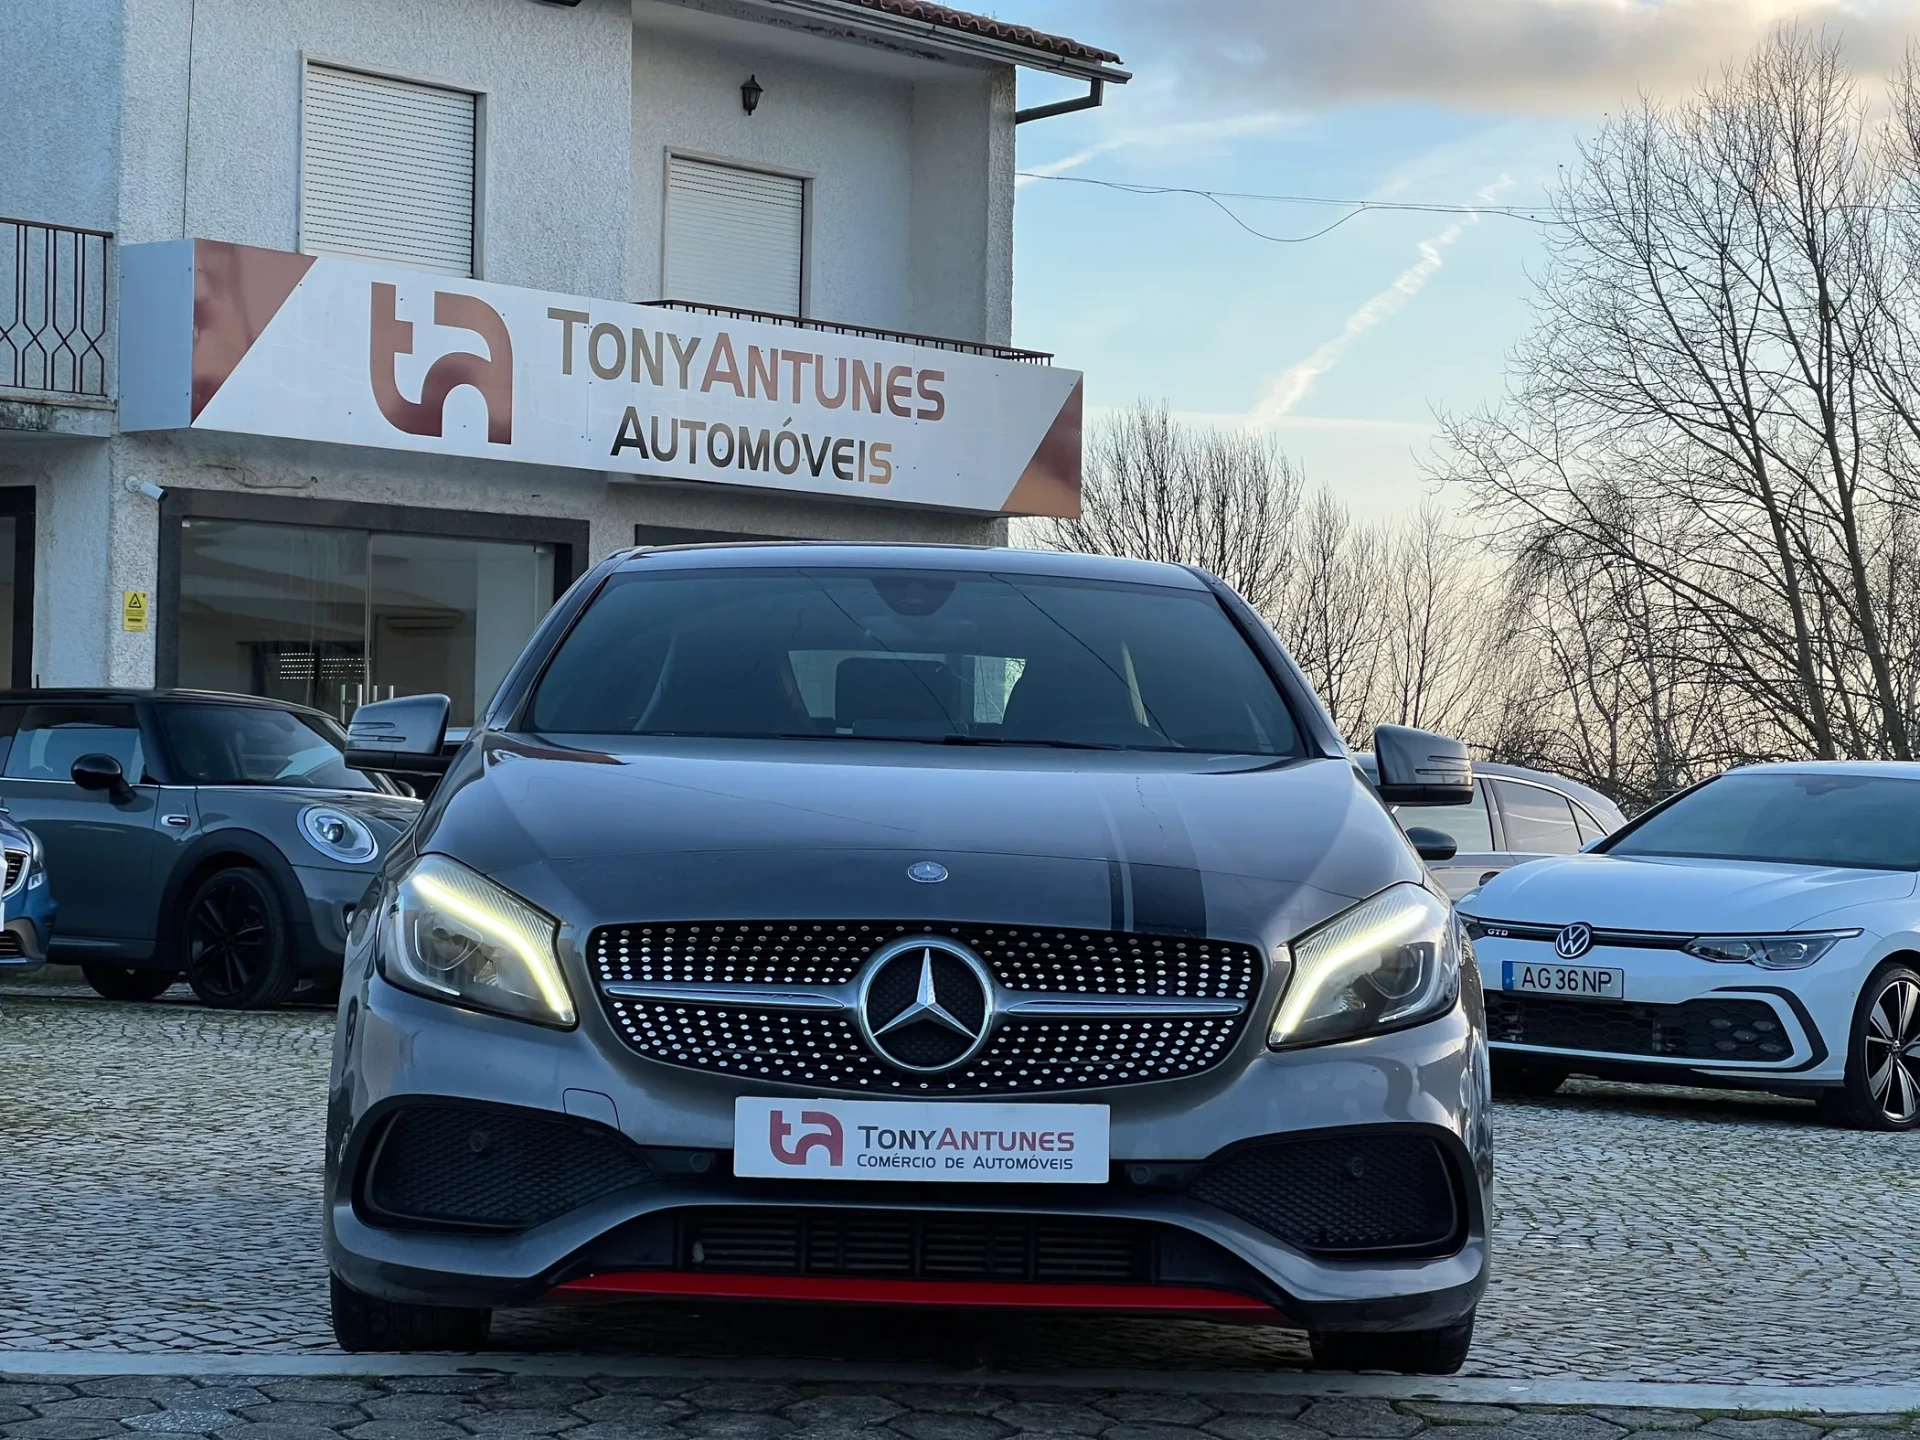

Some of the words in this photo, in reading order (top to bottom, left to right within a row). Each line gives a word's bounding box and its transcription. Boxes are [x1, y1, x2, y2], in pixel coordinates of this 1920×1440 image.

[610, 405, 893, 485] AUTOMÓVEIS
[1487, 928, 1509, 936] GTD
[857, 1153, 936, 1169] COMÉRCIO
[945, 1157, 965, 1169] DE
[973, 1154, 1073, 1170] AUTOMÓVEIS
